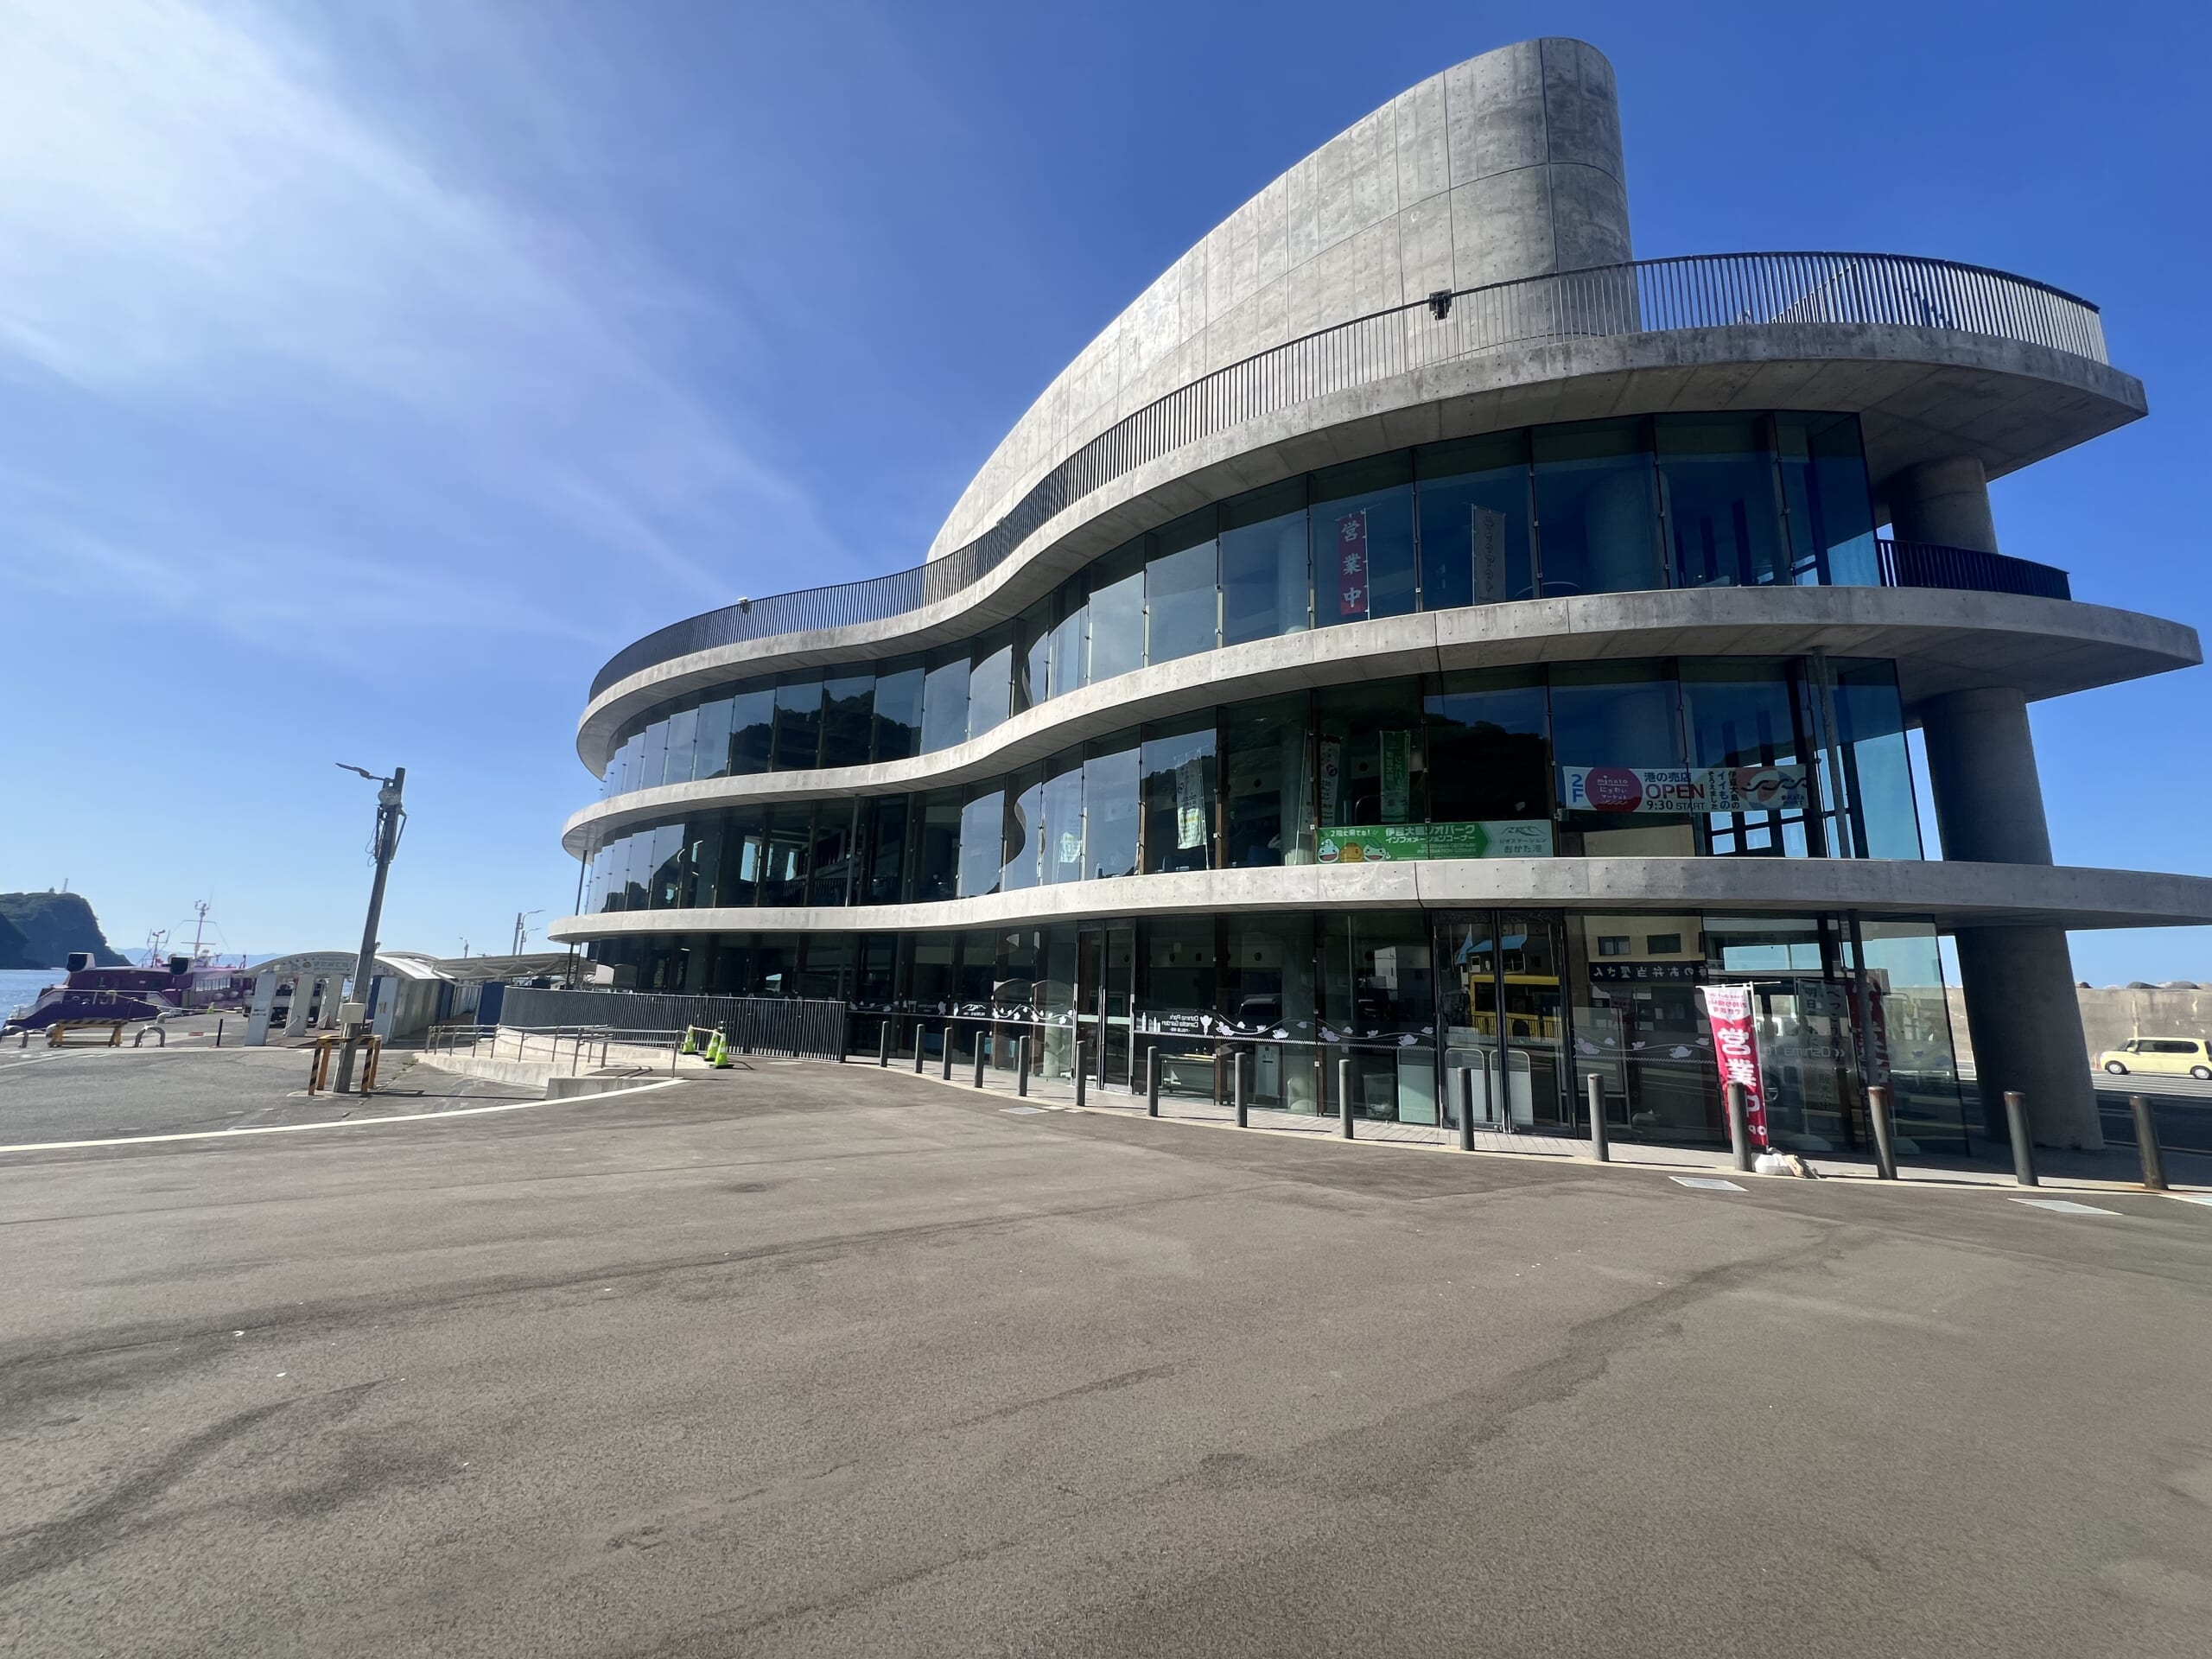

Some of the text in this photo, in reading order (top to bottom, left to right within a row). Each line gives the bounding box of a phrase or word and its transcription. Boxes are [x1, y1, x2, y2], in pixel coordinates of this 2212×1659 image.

[1341, 519, 1363, 608] 営業中
[1597, 775, 1629, 785] minato
[1643, 771, 1692, 783] 港の売店
[1571, 773, 1584, 803] 2F
[1645, 784, 1706, 799] OPEN
[1717, 771, 1731, 810] イイもの
[1727, 771, 1740, 810] 伊豆大島の
[1646, 799, 1706, 810] 9:30 START
[1385, 825, 1476, 836] 伊豆大島ジオパーク
